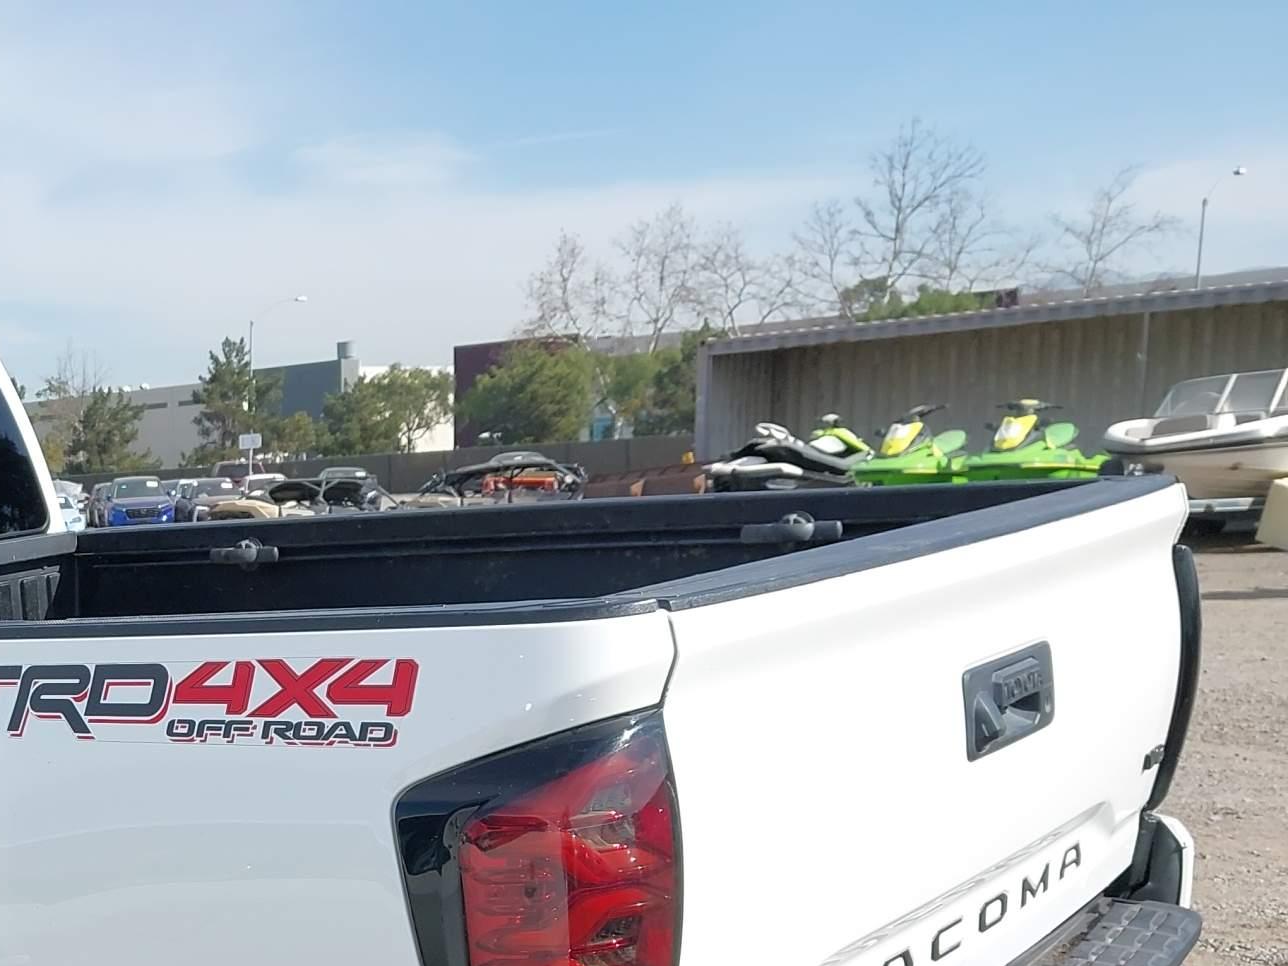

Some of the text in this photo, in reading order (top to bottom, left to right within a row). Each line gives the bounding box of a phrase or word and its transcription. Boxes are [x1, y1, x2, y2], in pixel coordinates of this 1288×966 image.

[172, 657, 420, 719] 4X4
[165, 718, 399, 747] OFF ROAD
